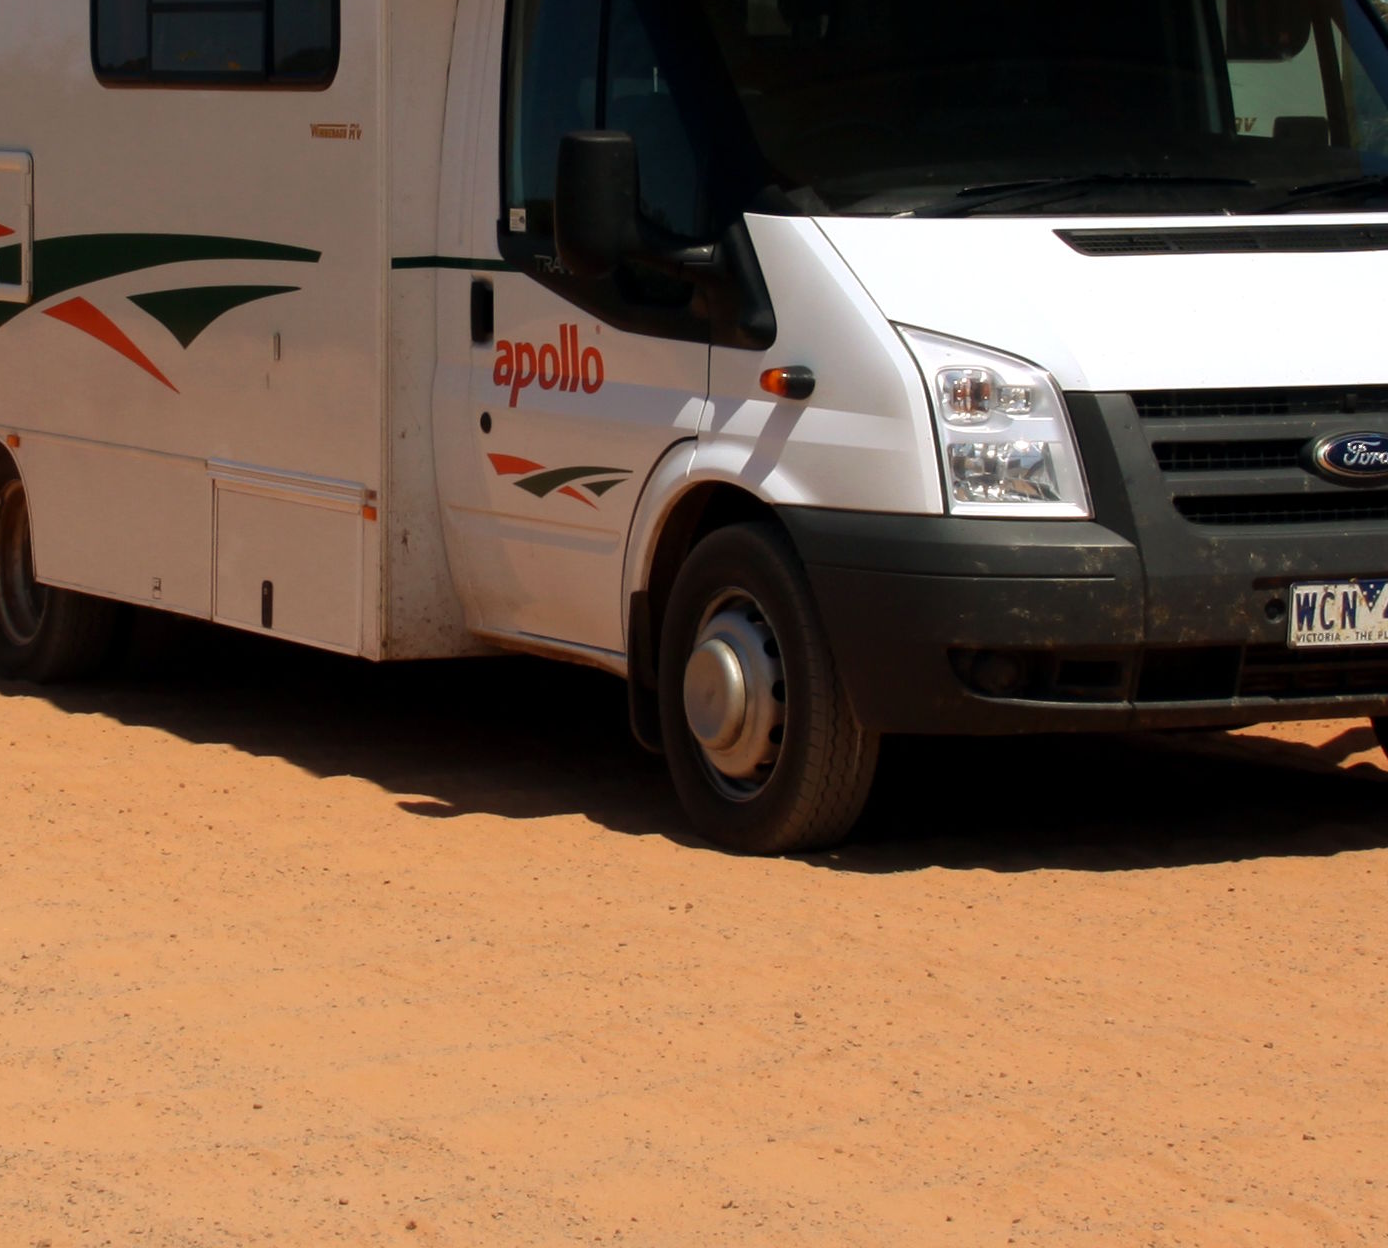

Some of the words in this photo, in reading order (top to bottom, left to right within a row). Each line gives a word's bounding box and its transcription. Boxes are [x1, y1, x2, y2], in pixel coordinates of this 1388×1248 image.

[493, 323, 604, 408] apollo
[1296, 591, 1357, 631] WCN
[1296, 632, 1340, 642] VICTORIA
[1355, 631, 1372, 641] THE
